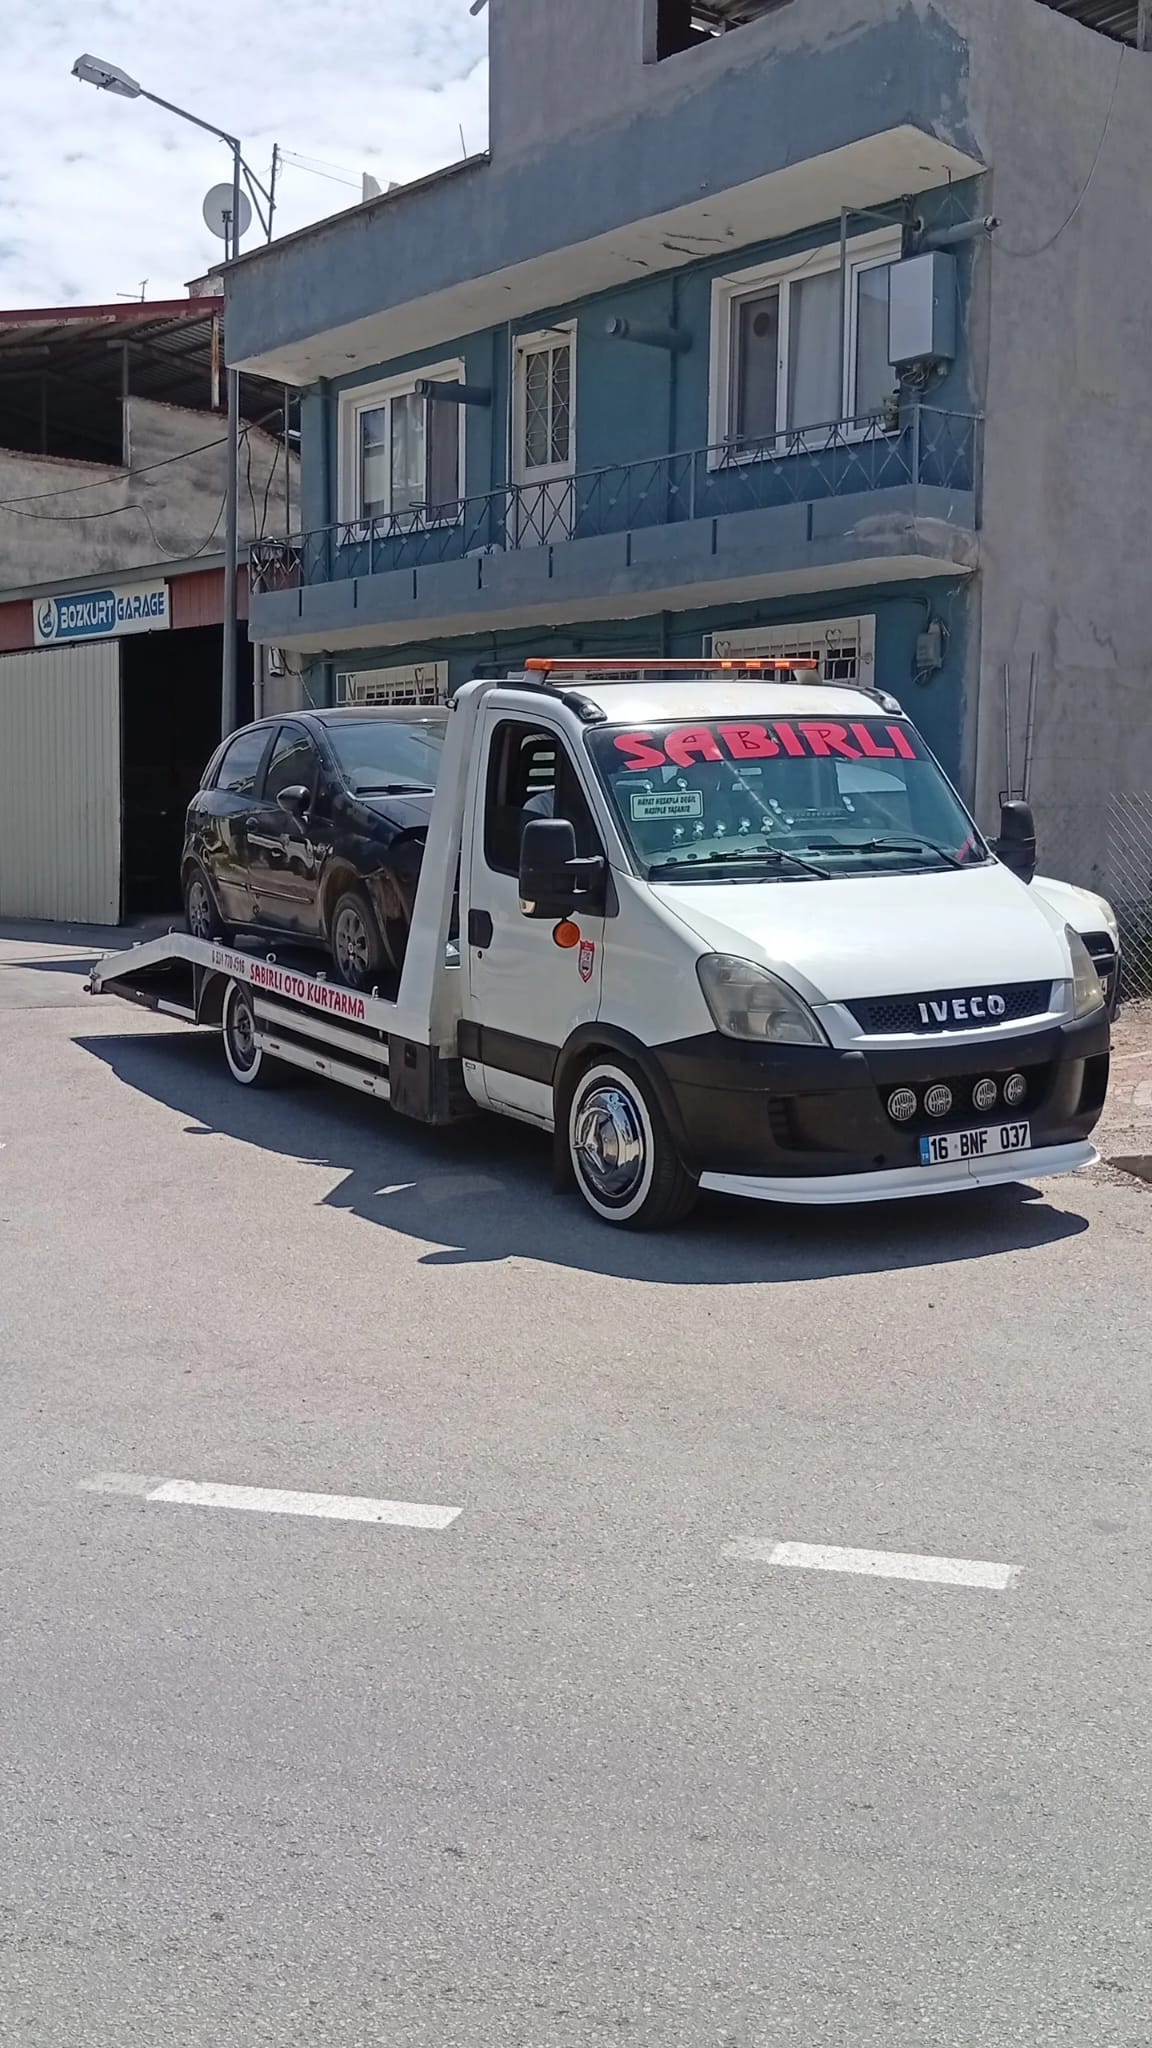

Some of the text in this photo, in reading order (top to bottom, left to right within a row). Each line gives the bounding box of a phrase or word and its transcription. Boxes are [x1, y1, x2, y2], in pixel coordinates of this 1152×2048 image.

[61, 592, 165, 629] BOZKURT GARAGE
[613, 722, 916, 770] SABIRLI
[250, 963, 365, 1020] SABIRLI OTO KURTARMA
[918, 994, 1006, 1023] IVECO
[930, 1123, 1028, 1160] 16 BNF 037
